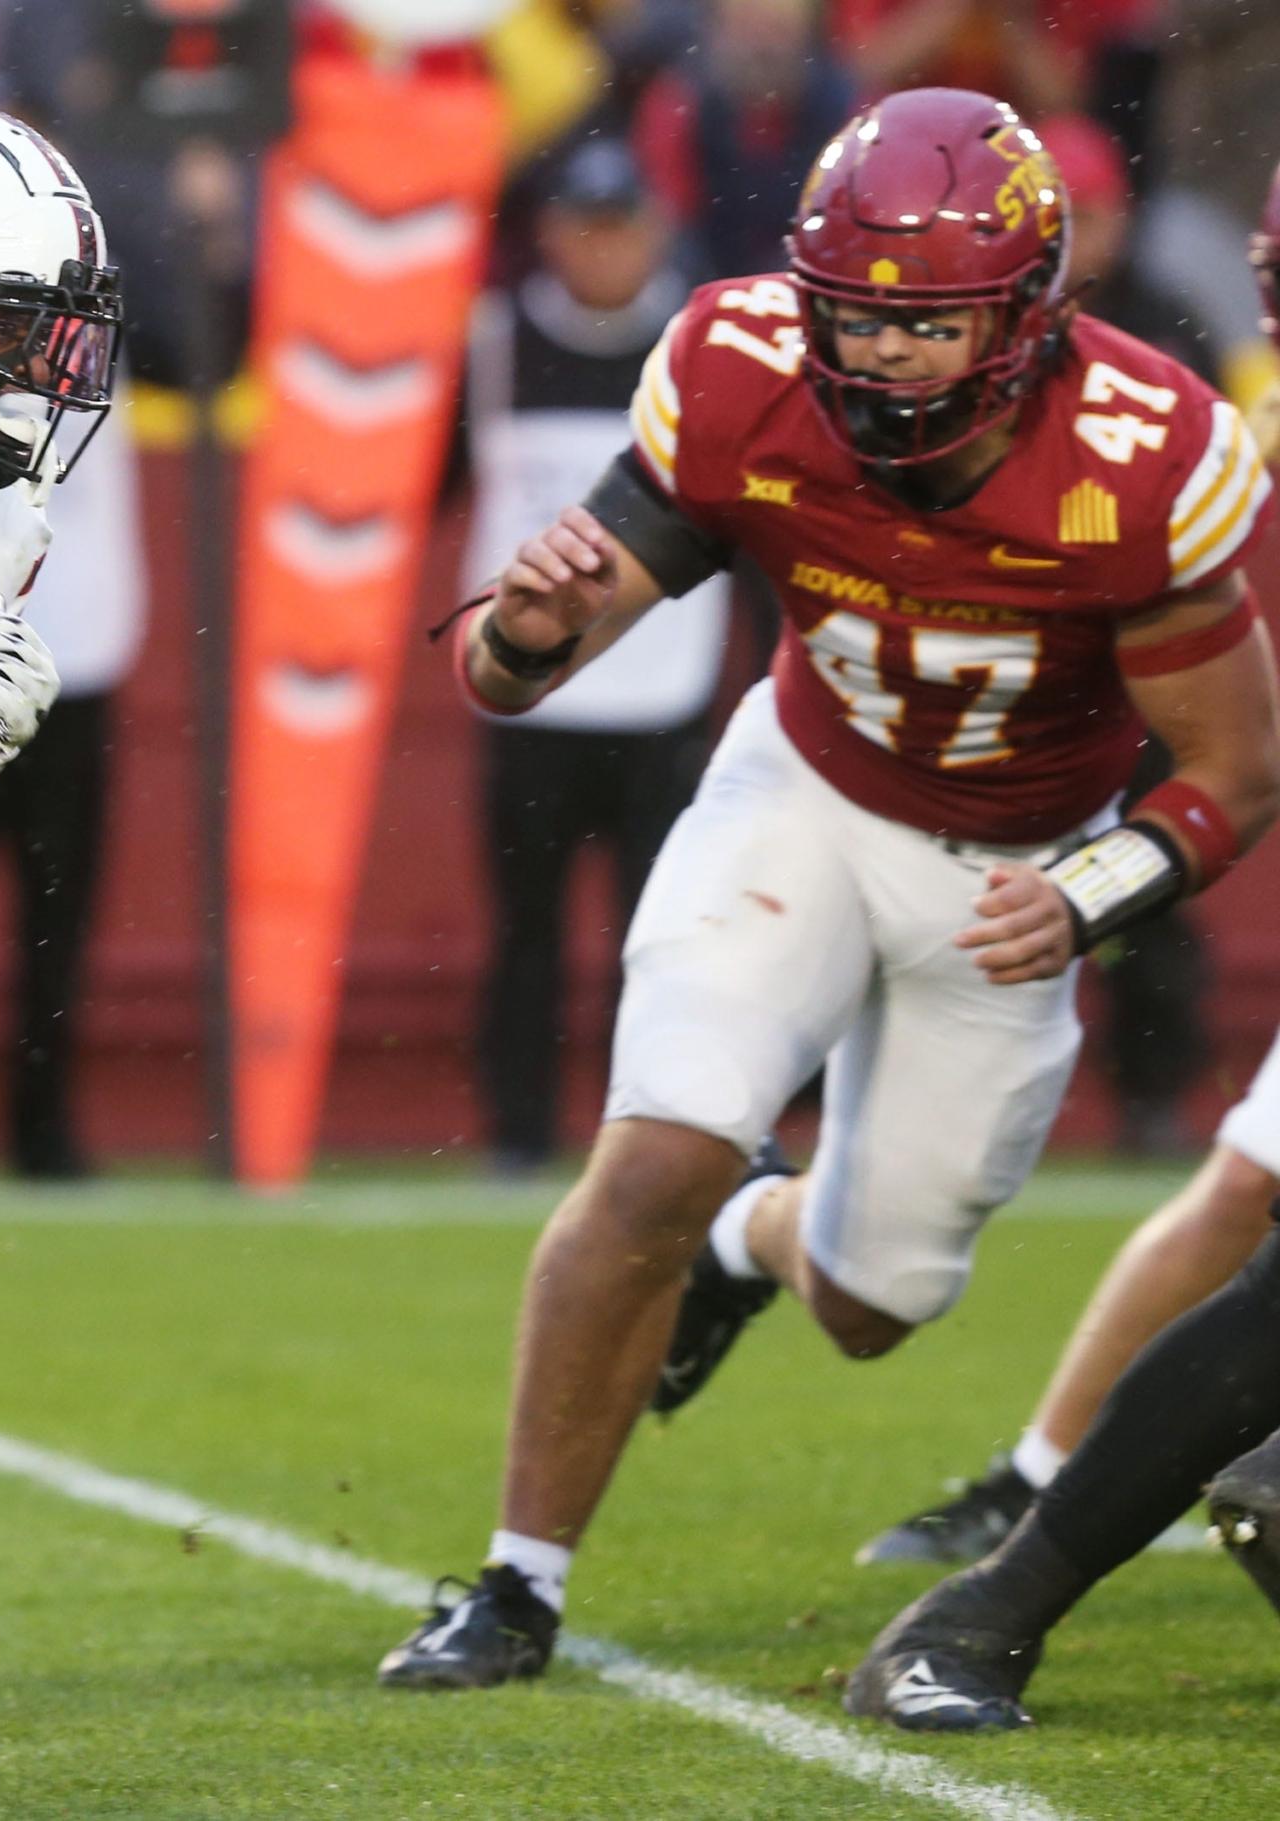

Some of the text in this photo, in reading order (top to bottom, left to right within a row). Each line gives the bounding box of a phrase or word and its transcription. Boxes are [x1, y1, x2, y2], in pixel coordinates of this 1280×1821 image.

[704, 279, 803, 377] 47
[1073, 360, 1179, 465] 47
[788, 562, 891, 611] IOWA
[800, 610, 1045, 770] 47
